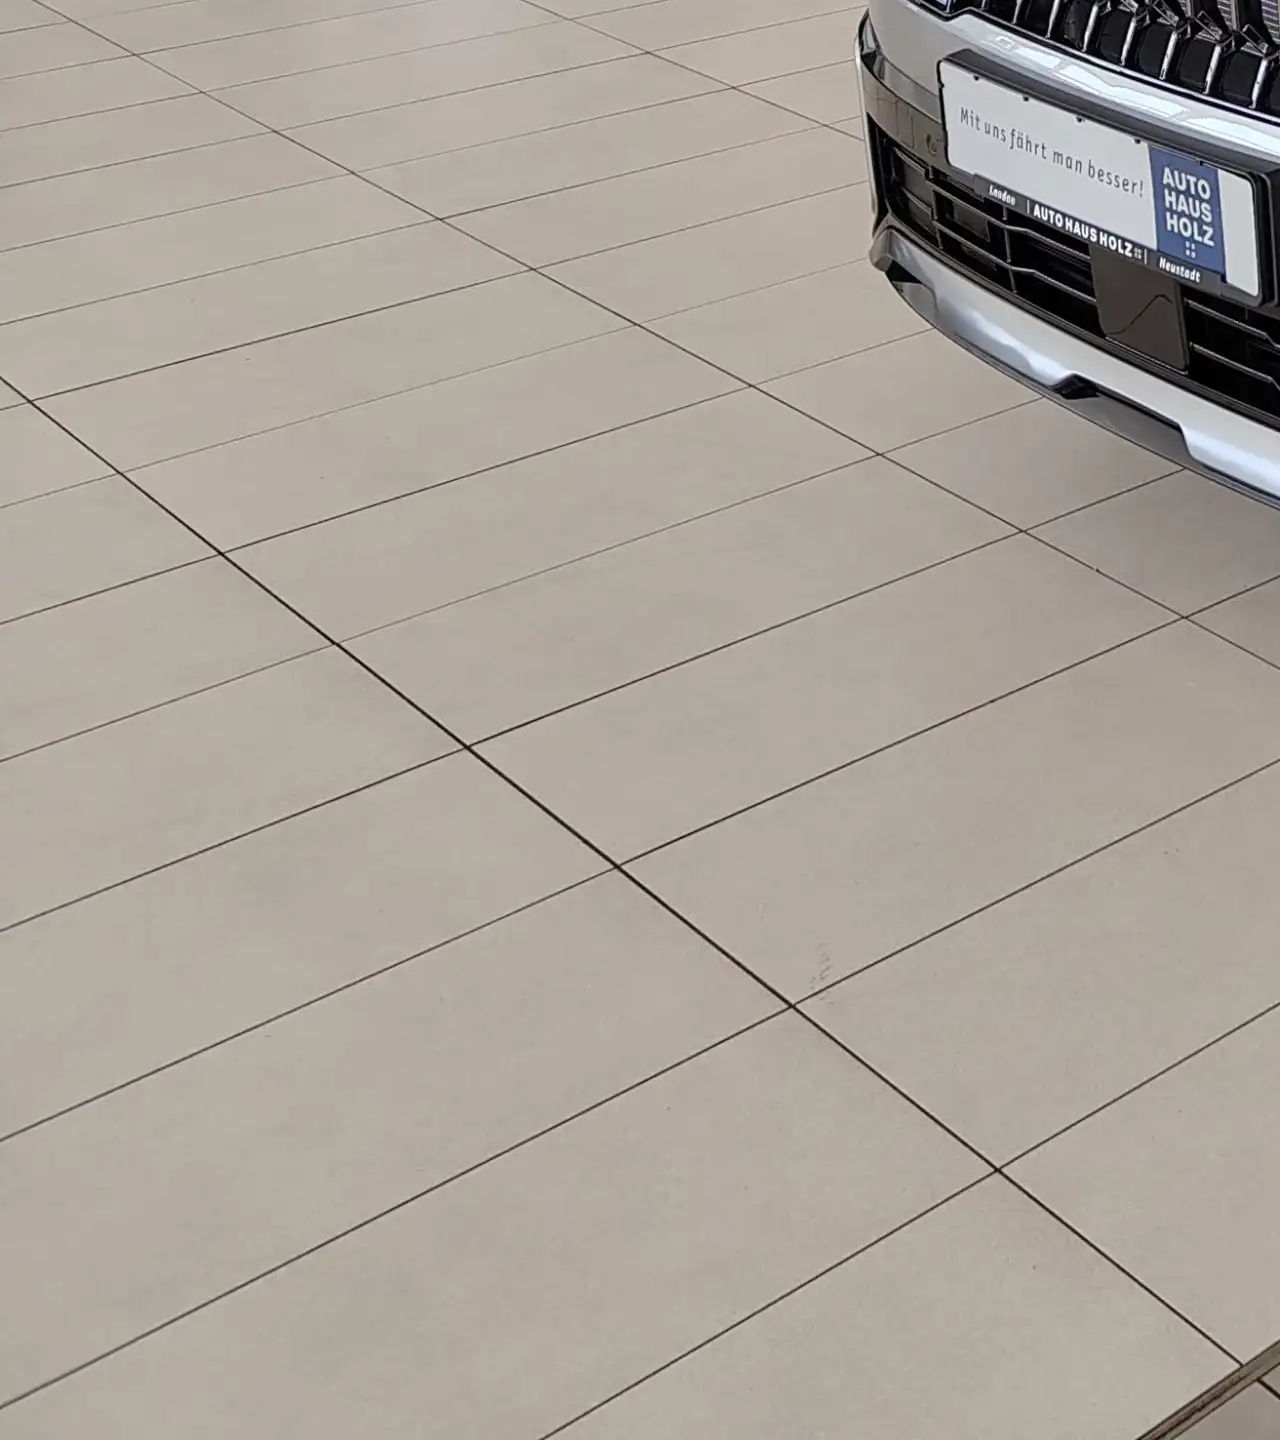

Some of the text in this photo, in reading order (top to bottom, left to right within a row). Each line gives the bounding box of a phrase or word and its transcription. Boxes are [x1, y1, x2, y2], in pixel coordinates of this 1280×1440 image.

[960, 107, 1145, 198] Mit uns fährt man besser!
[1162, 166, 1211, 200] AUTO
[1164, 188, 1213, 223] HAUS
[1033, 204, 1133, 257] AUTO HAUS HOLZ
[1166, 211, 1215, 247] HOLZ
[1159, 256, 1201, 283] Neustadt
